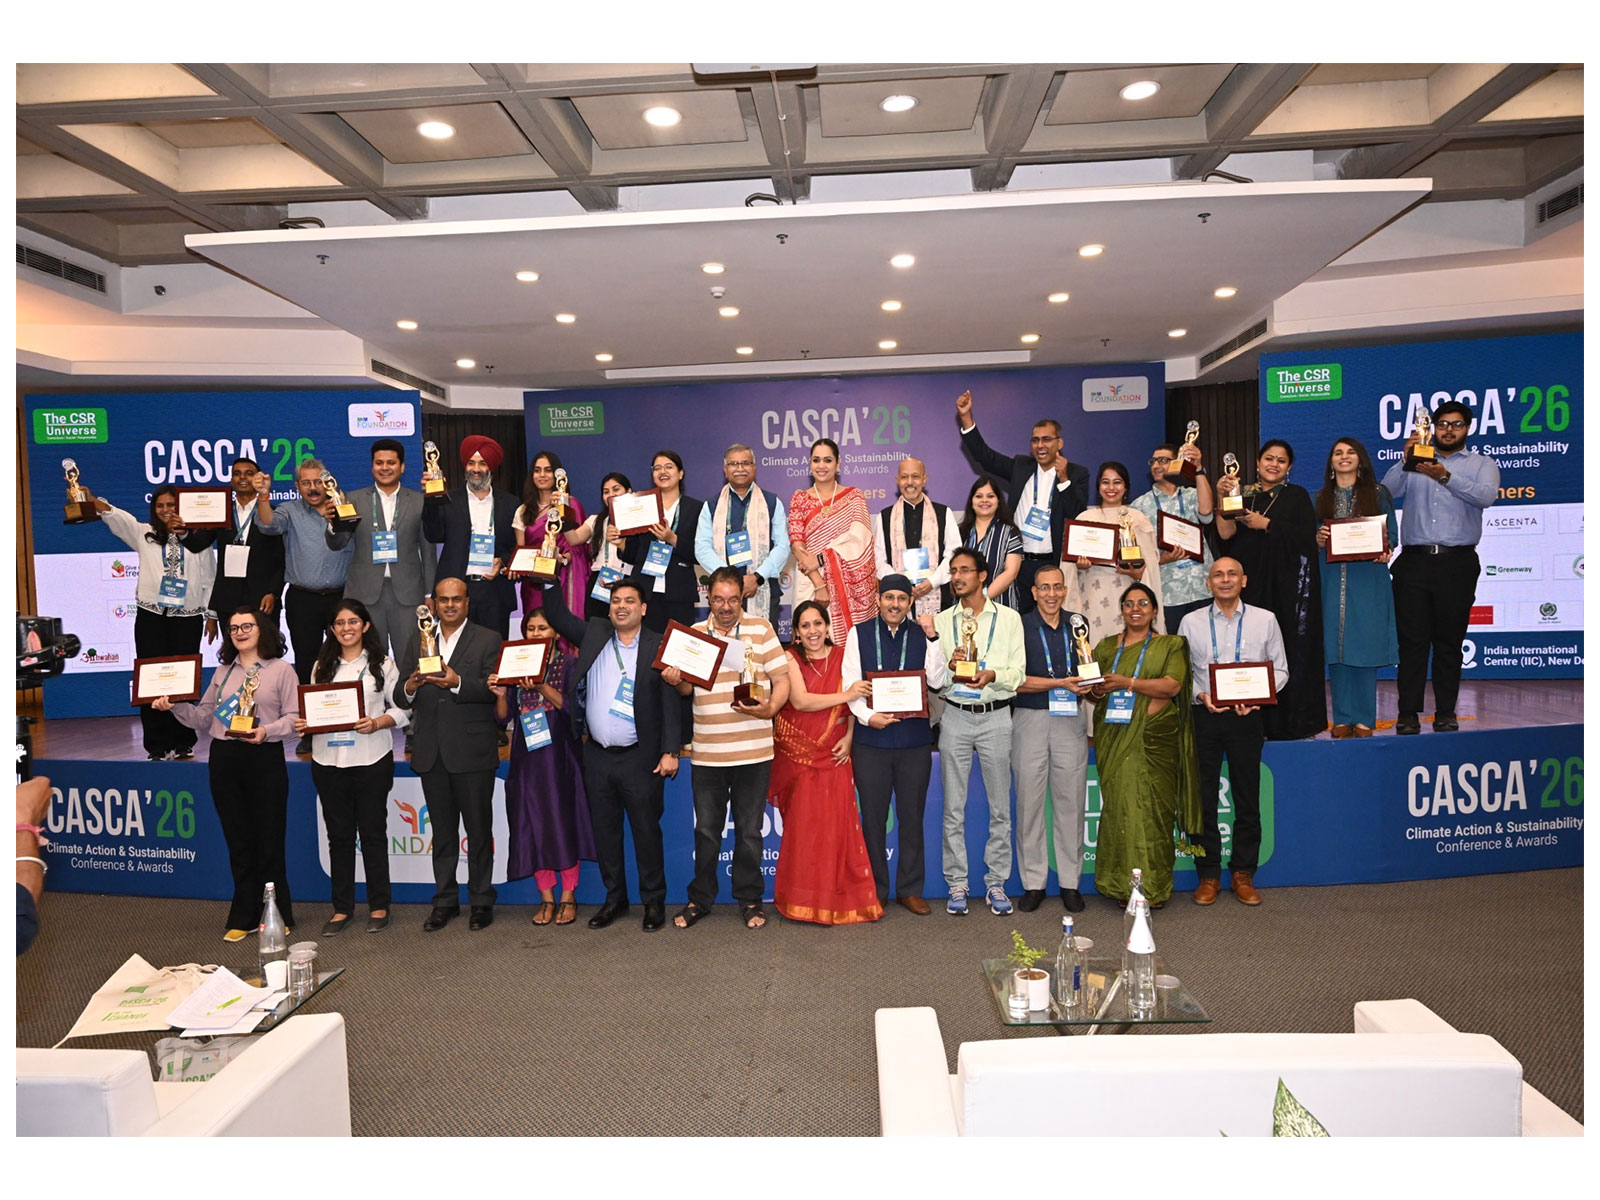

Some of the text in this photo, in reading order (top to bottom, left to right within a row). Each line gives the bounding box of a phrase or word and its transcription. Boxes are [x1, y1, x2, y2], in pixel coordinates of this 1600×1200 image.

[1277, 369, 1330, 383] The CSR
[1280, 383, 1331, 394] Universe
[1090, 394, 1141, 403] FOUNDATION
[42, 412, 96, 424] The CSR
[547, 406, 593, 418] The CSR
[46, 425, 97, 436] Universe
[551, 420, 594, 429] Universe
[762, 405, 911, 450] CASCA'26
[1377, 442, 1569, 461] Clim & Sustainability
[761, 456, 799, 467] Climate
[845, 452, 911, 464] Sustainability
[1495, 456, 1540, 469] Awards
[843, 465, 851, 475] &
[853, 463, 889, 475] Awards
[1486, 517, 1538, 527] ASCENTA
[1498, 566, 1533, 574] Greenway
[1483, 644, 1578, 655] India International
[1483, 656, 1518, 666] Centre
[1520, 656, 1546, 668] (IIC),
[1548, 656, 1571, 666] New
[1407, 756, 1584, 817] CASCA'26
[47, 787, 196, 839] CASCA'26
[1405, 816, 1584, 840] Climate Action & Sustainability
[1436, 833, 1558, 854] Conference & Awards
[46, 842, 196, 863] Climate Action & Sustainability
[71, 857, 174, 874] Conference & Awards
